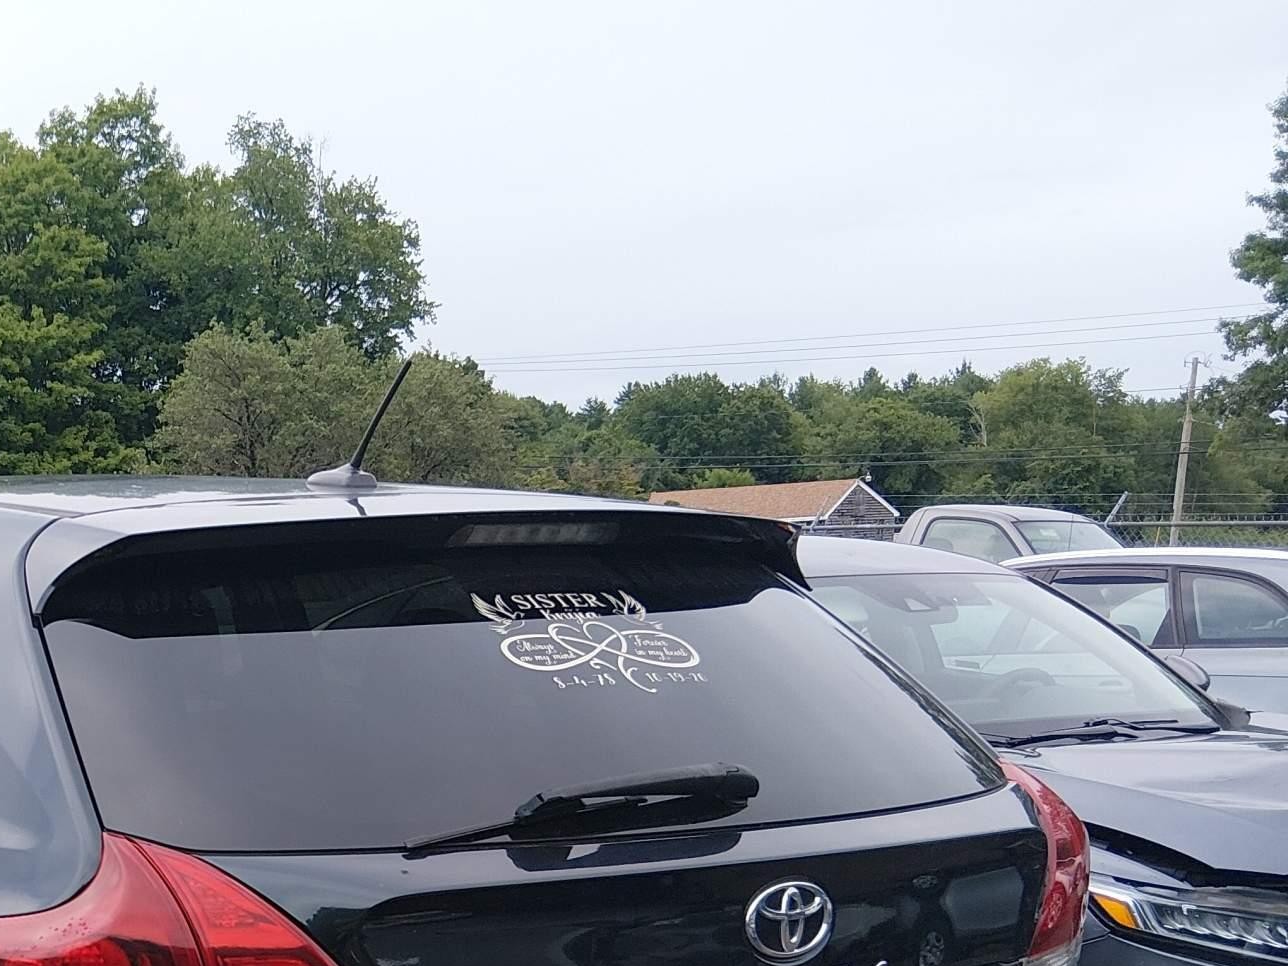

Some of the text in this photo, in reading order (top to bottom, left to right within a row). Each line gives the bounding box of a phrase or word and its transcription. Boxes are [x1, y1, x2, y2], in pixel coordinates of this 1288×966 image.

[511, 592, 605, 609] SISTER
[516, 640, 554, 654] Always
[535, 655, 550, 665] my
[552, 650, 577, 660] mind
[648, 650, 665, 661] my
